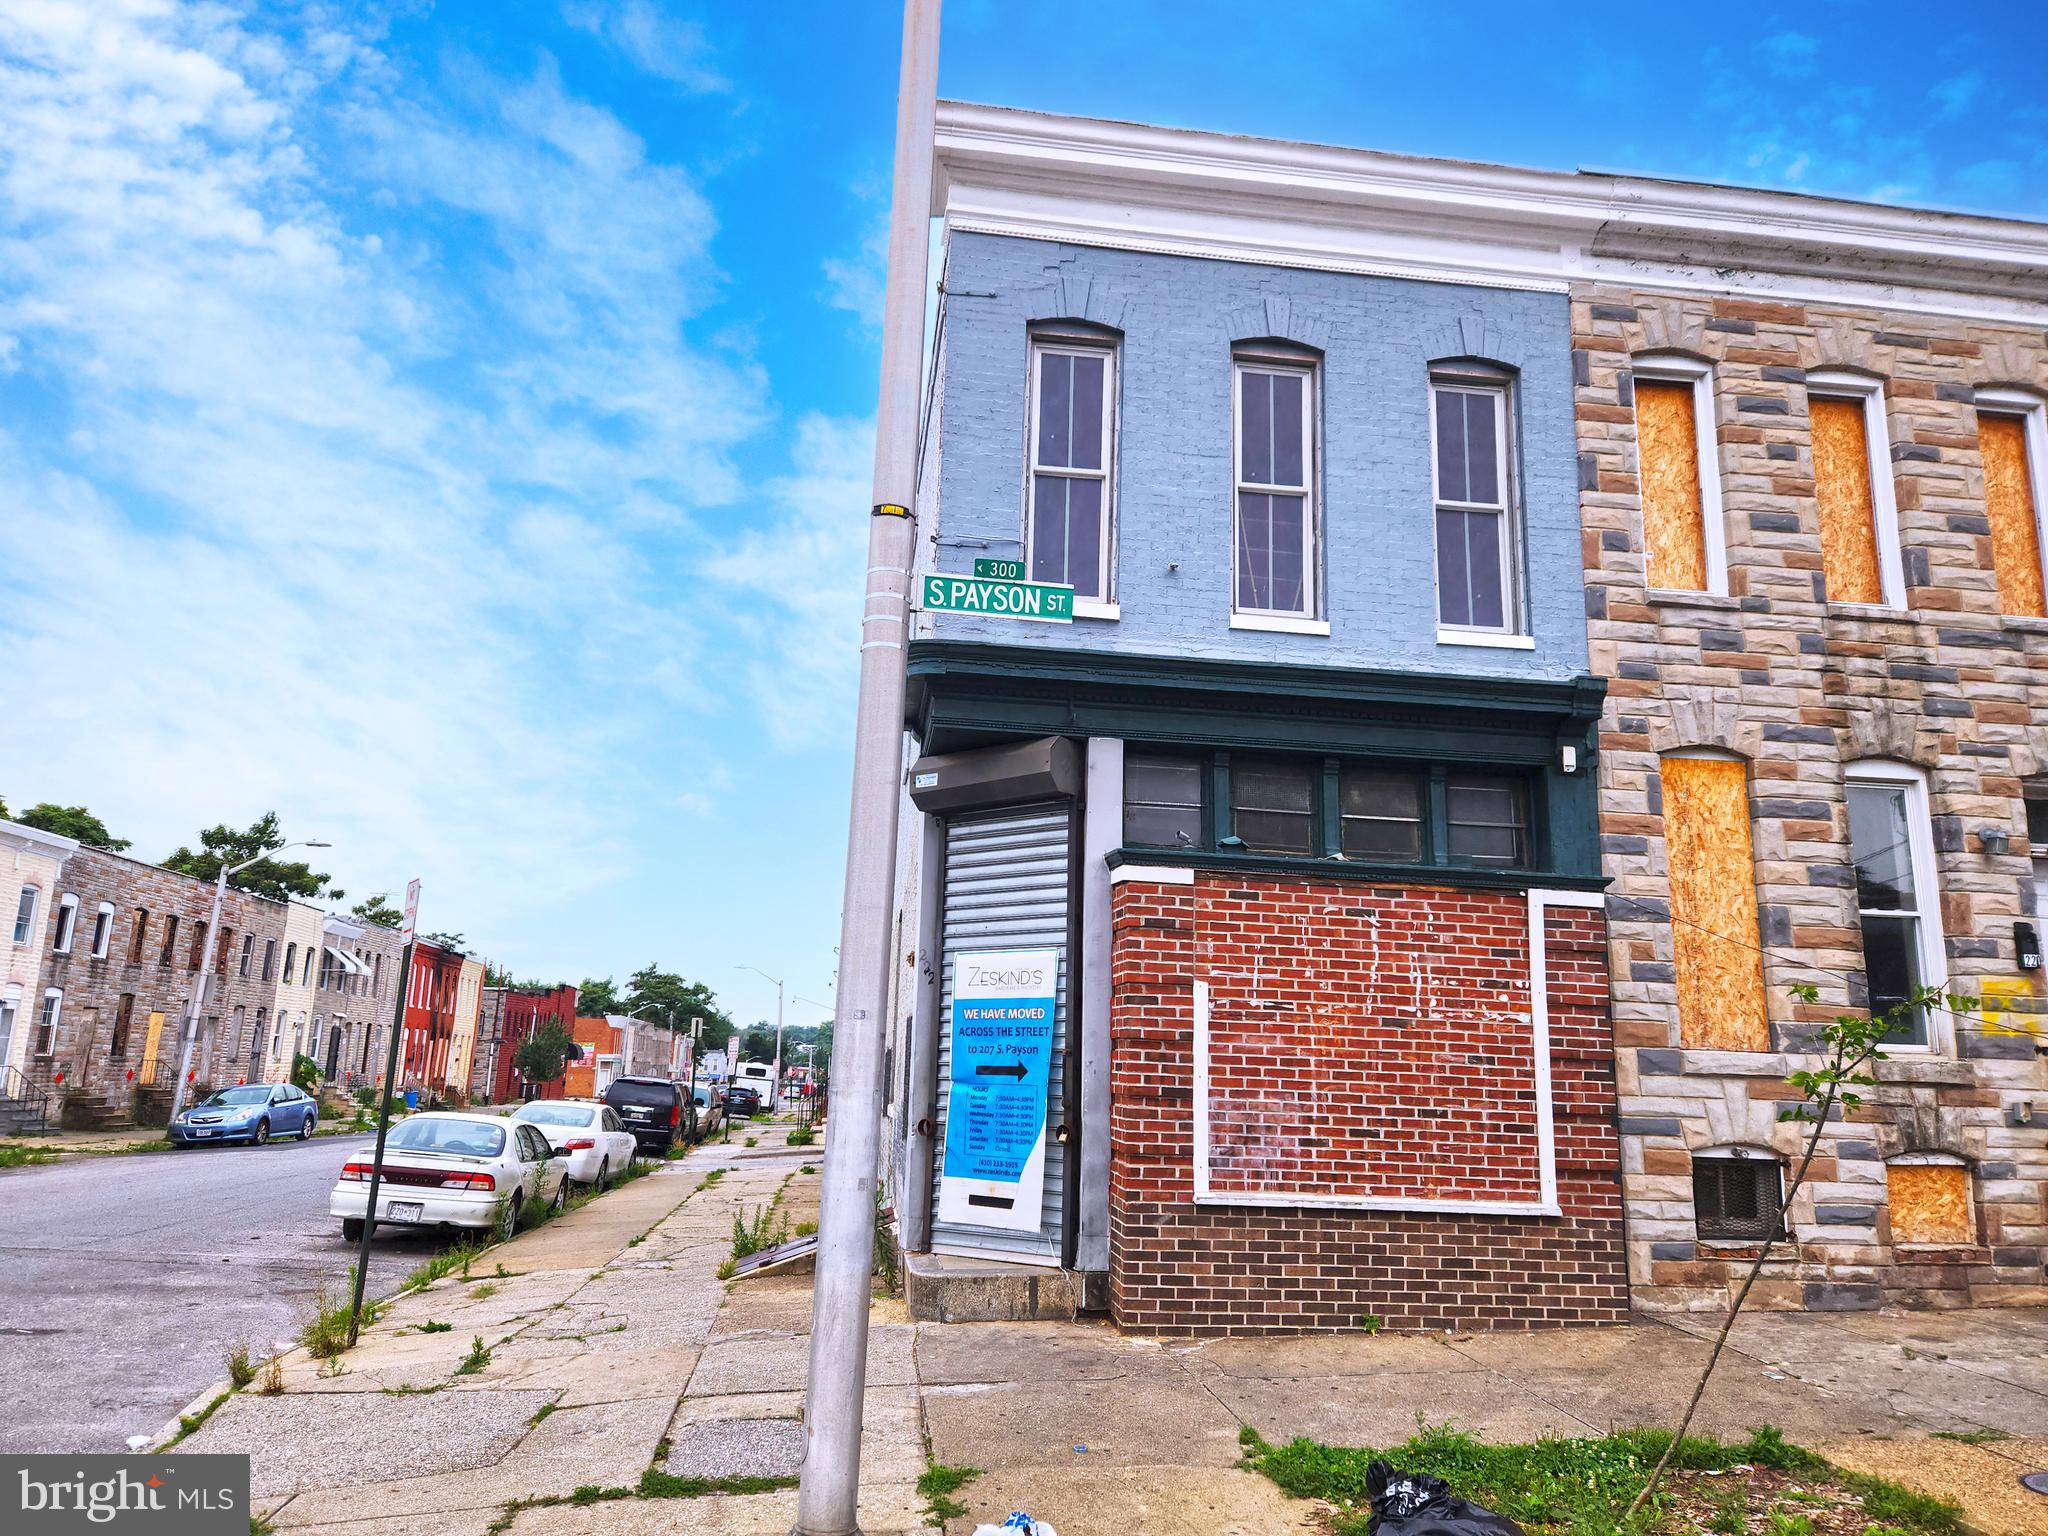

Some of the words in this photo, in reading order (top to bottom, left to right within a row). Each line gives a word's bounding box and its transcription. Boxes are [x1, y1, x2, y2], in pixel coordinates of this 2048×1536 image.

[990, 562, 1017, 578] 300
[1046, 594, 1066, 612] ST.
[967, 966, 1044, 987] ZESKIND'S
[963, 1008, 979, 1019] WE
[980, 1008, 1006, 1019] HAVE
[1007, 1008, 1046, 1019] MOVED
[959, 1027, 994, 1037] ACROSS
[996, 1027, 1013, 1037] THE
[1015, 1026, 1050, 1037] STREET
[967, 1044, 977, 1054] to
[979, 1045, 995, 1056] 207
[996, 1044, 1004, 1054] S.
[1006, 1044, 1039, 1057] Payson
